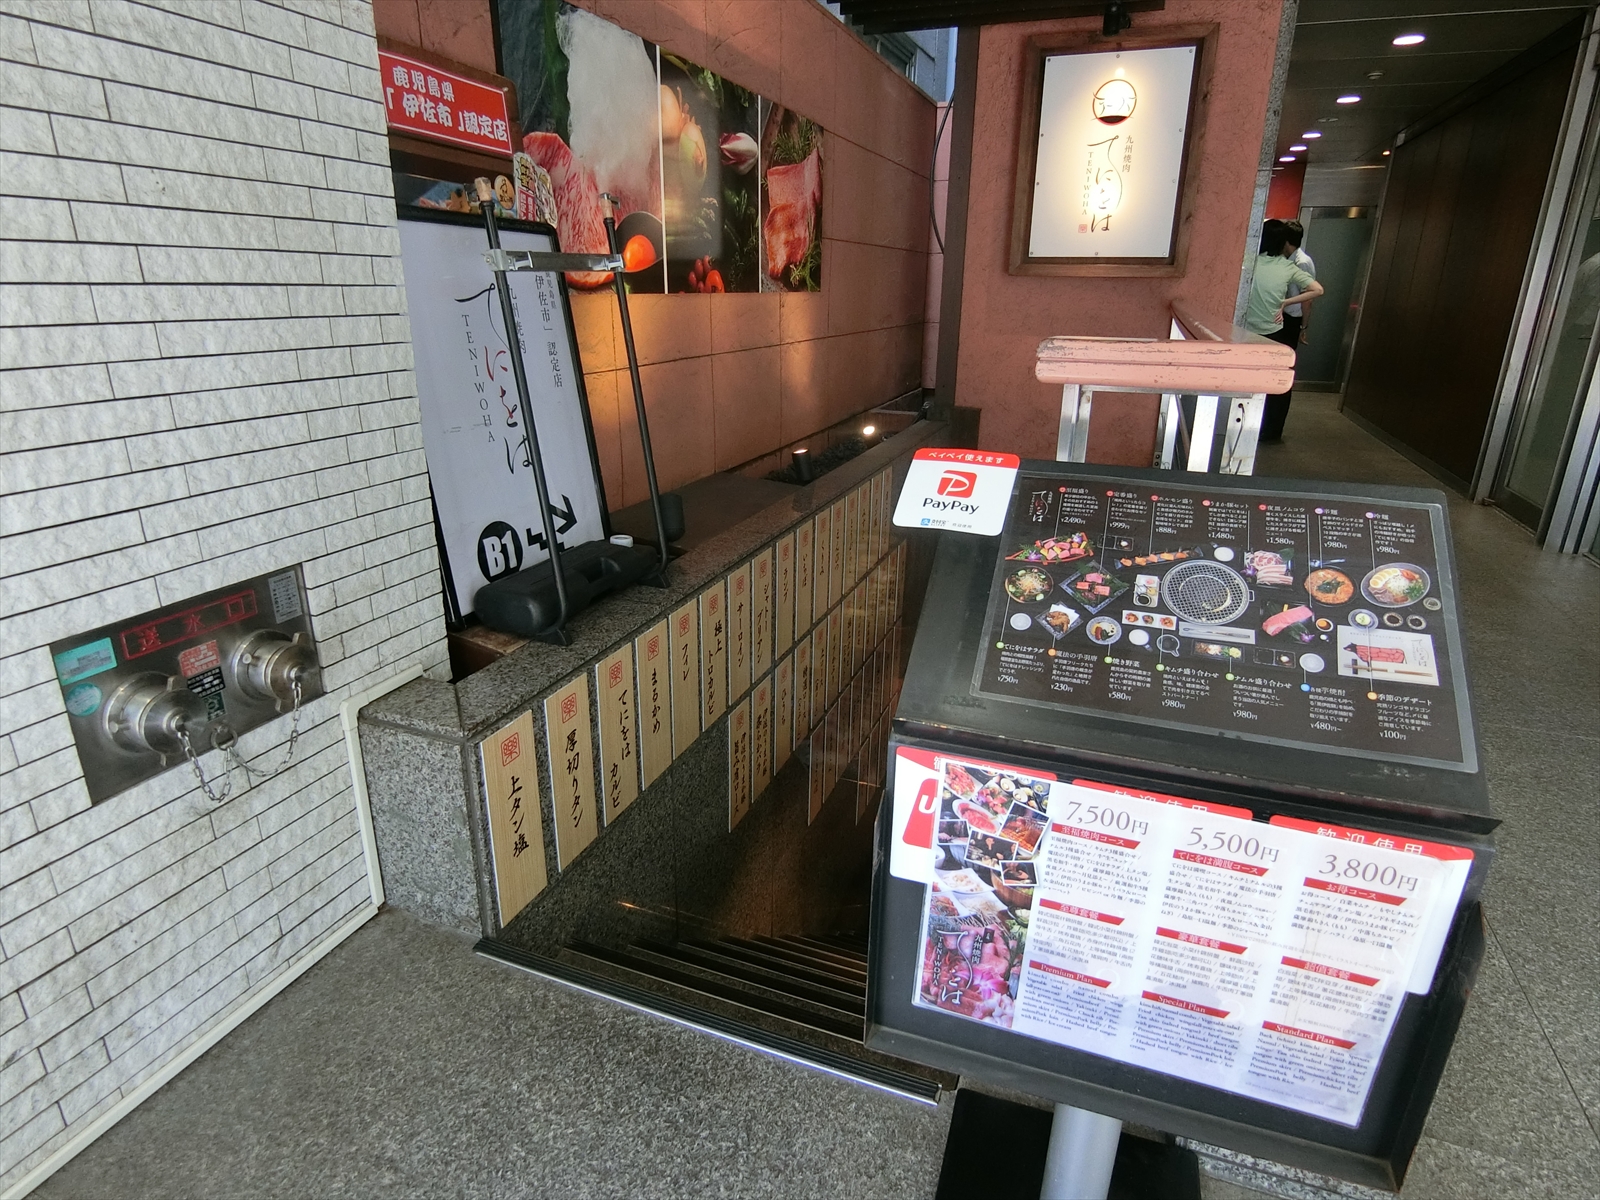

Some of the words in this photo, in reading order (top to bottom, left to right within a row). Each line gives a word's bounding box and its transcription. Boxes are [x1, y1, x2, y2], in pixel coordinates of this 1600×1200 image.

[393, 65, 455, 103] 鹿児島県
[1121, 134, 1134, 173] 九州焼肉
[461, 314, 496, 443] TENIWOHA
[922, 497, 980, 515] PayPay
[482, 529, 518, 578] B1
[736, 601, 745, 668] サーロイン
[681, 642, 690, 682] フィレ
[996, 673, 1019, 684] ¥750円
[1050, 682, 1073, 692] ¥230円
[1107, 690, 1132, 701] ¥580円
[1161, 698, 1186, 709] ¥980円
[617, 688, 631, 761] てにをは
[1232, 708, 1258, 720] ¥980円
[1379, 728, 1406, 741] ¥100円
[564, 727, 584, 829] 厚切りタン
[609, 762, 623, 809] カルビ
[507, 773, 531, 859] 上タン塩
[1065, 800, 1149, 837] 7,500円
[1060, 825, 1125, 846] 至福焼肉コース
[1186, 825, 1281, 865] 5,500円
[1317, 852, 1420, 893] 3,800円
[1325, 882, 1378, 901] お得コース
[932, 936, 944, 986] TENIWOHA
[971, 934, 983, 965] 九州焼肉
[1040, 962, 1074, 979] Premium
[1076, 973, 1093, 984] Plan
[1157, 994, 1186, 1009] Special
[1188, 1002, 1206, 1013] Plan
[1274, 1022, 1314, 1041] Standard
[1315, 1033, 1335, 1045] Plan
